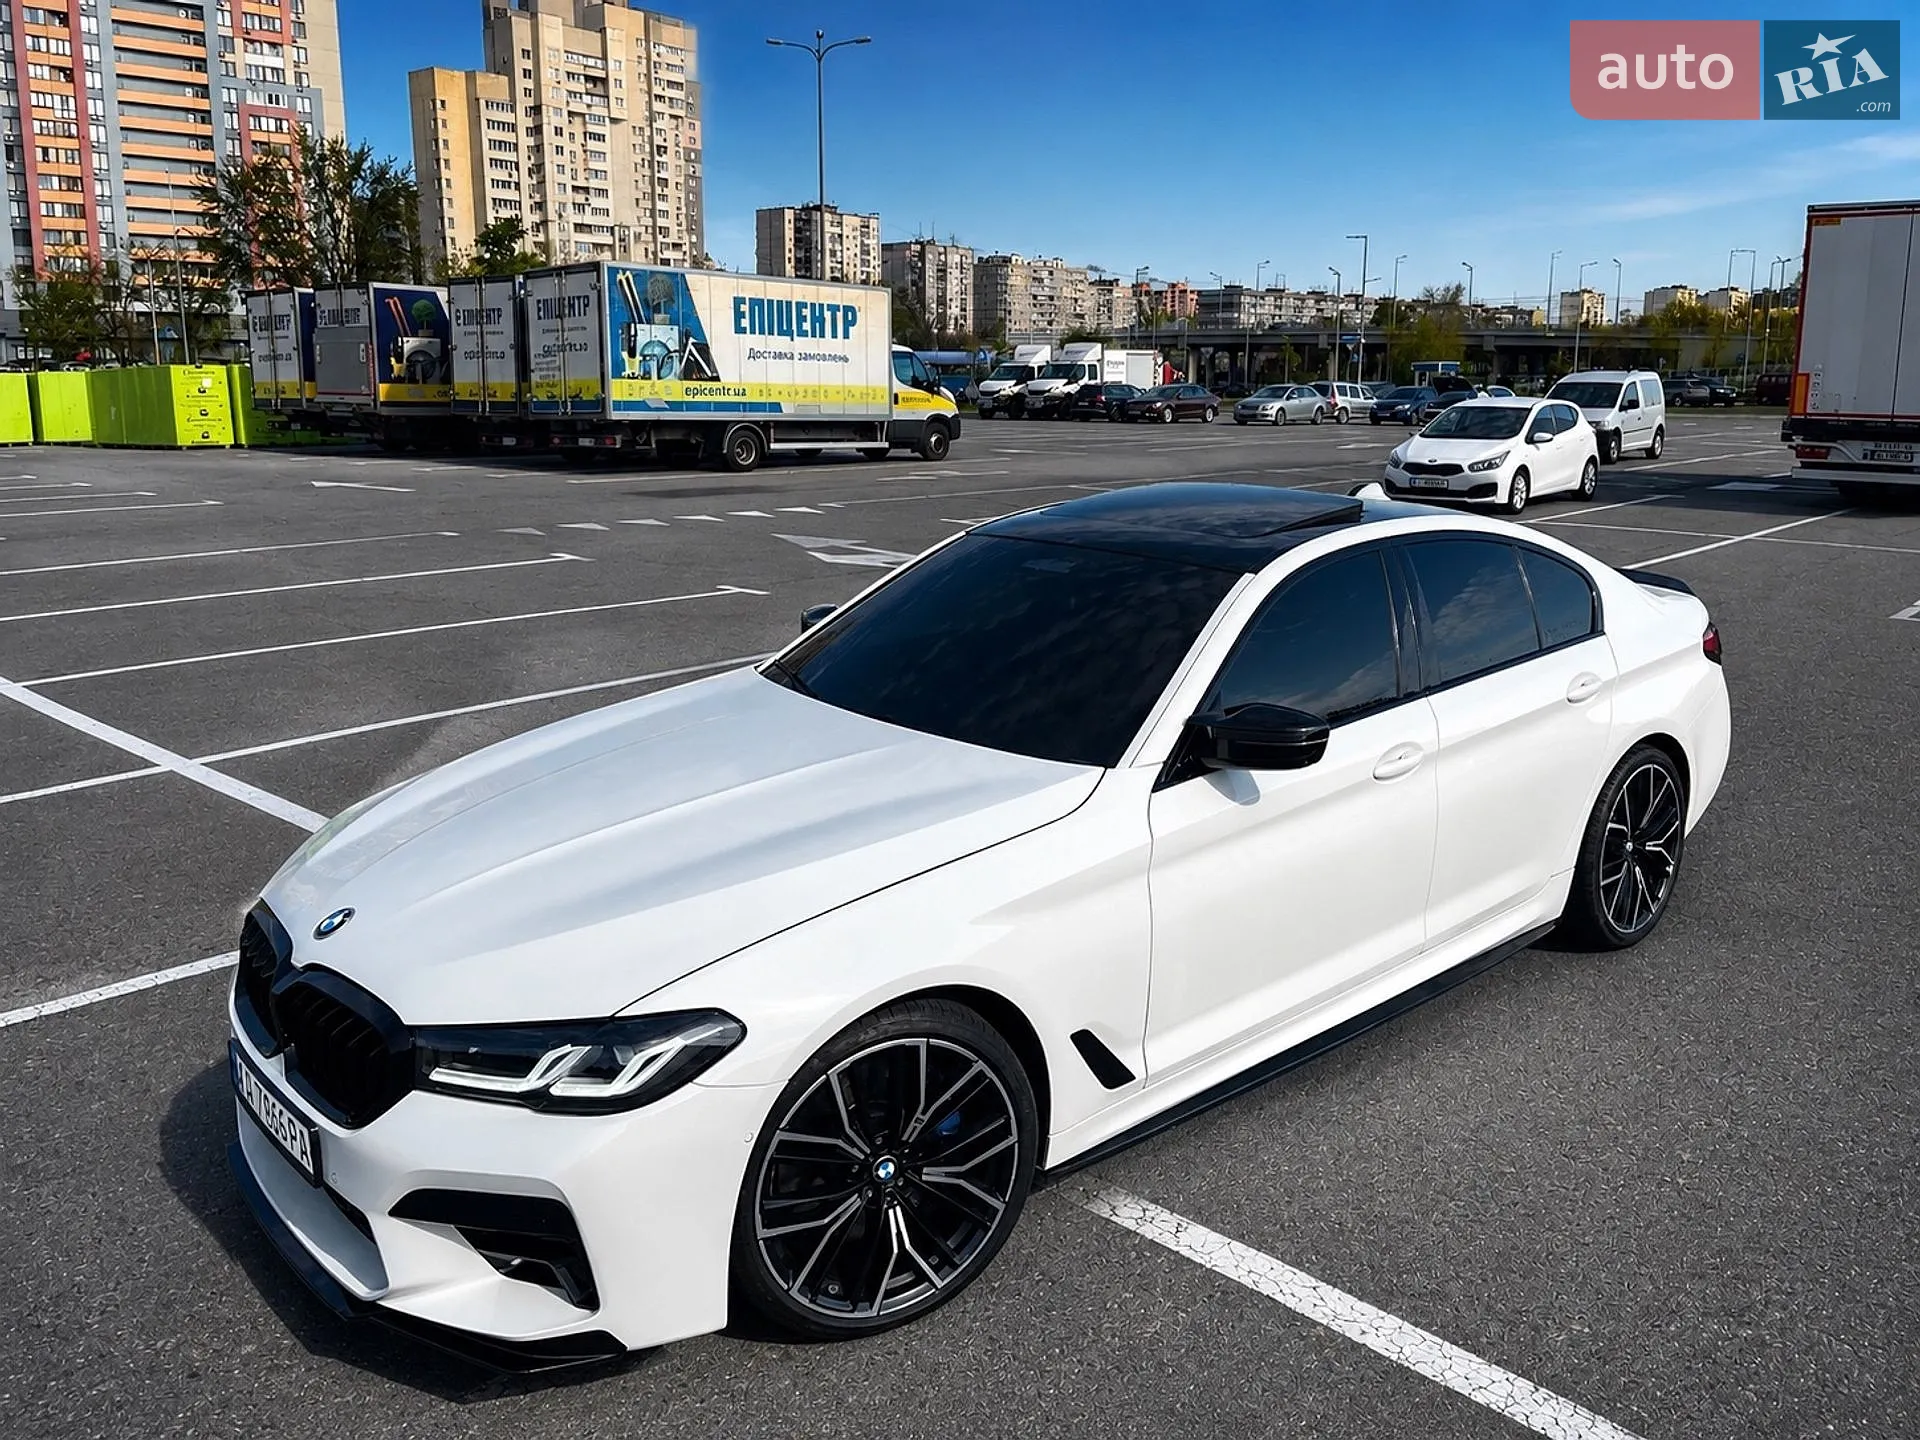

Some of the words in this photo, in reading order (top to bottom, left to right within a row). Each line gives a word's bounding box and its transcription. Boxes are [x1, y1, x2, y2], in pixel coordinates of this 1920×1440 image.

[733, 296, 858, 341] ЕПІЦЕНТР
[747, 347, 794, 361] Доставка
[798, 351, 850, 363] замовлень
